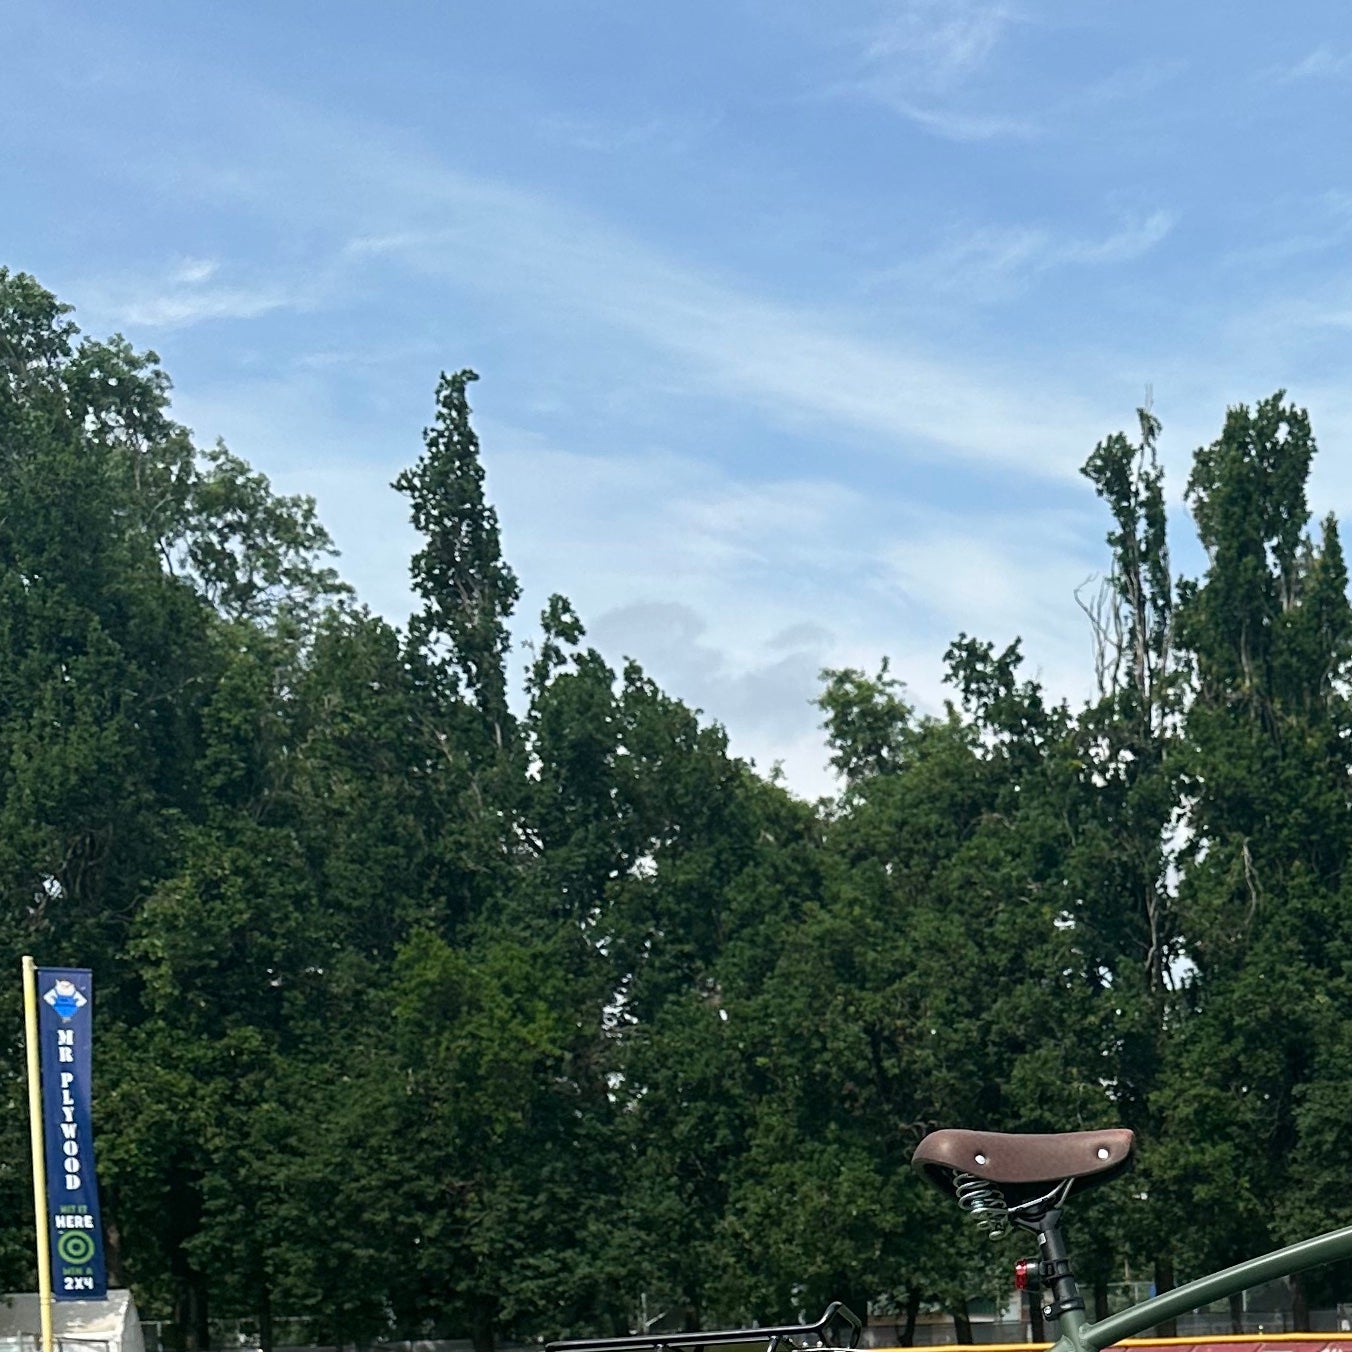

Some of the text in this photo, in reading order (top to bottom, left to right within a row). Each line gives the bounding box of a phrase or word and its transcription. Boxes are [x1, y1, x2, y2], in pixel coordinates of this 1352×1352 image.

[57, 1029, 82, 1191] MR PLYWOOD
[54, 1214, 95, 1229] HERE
